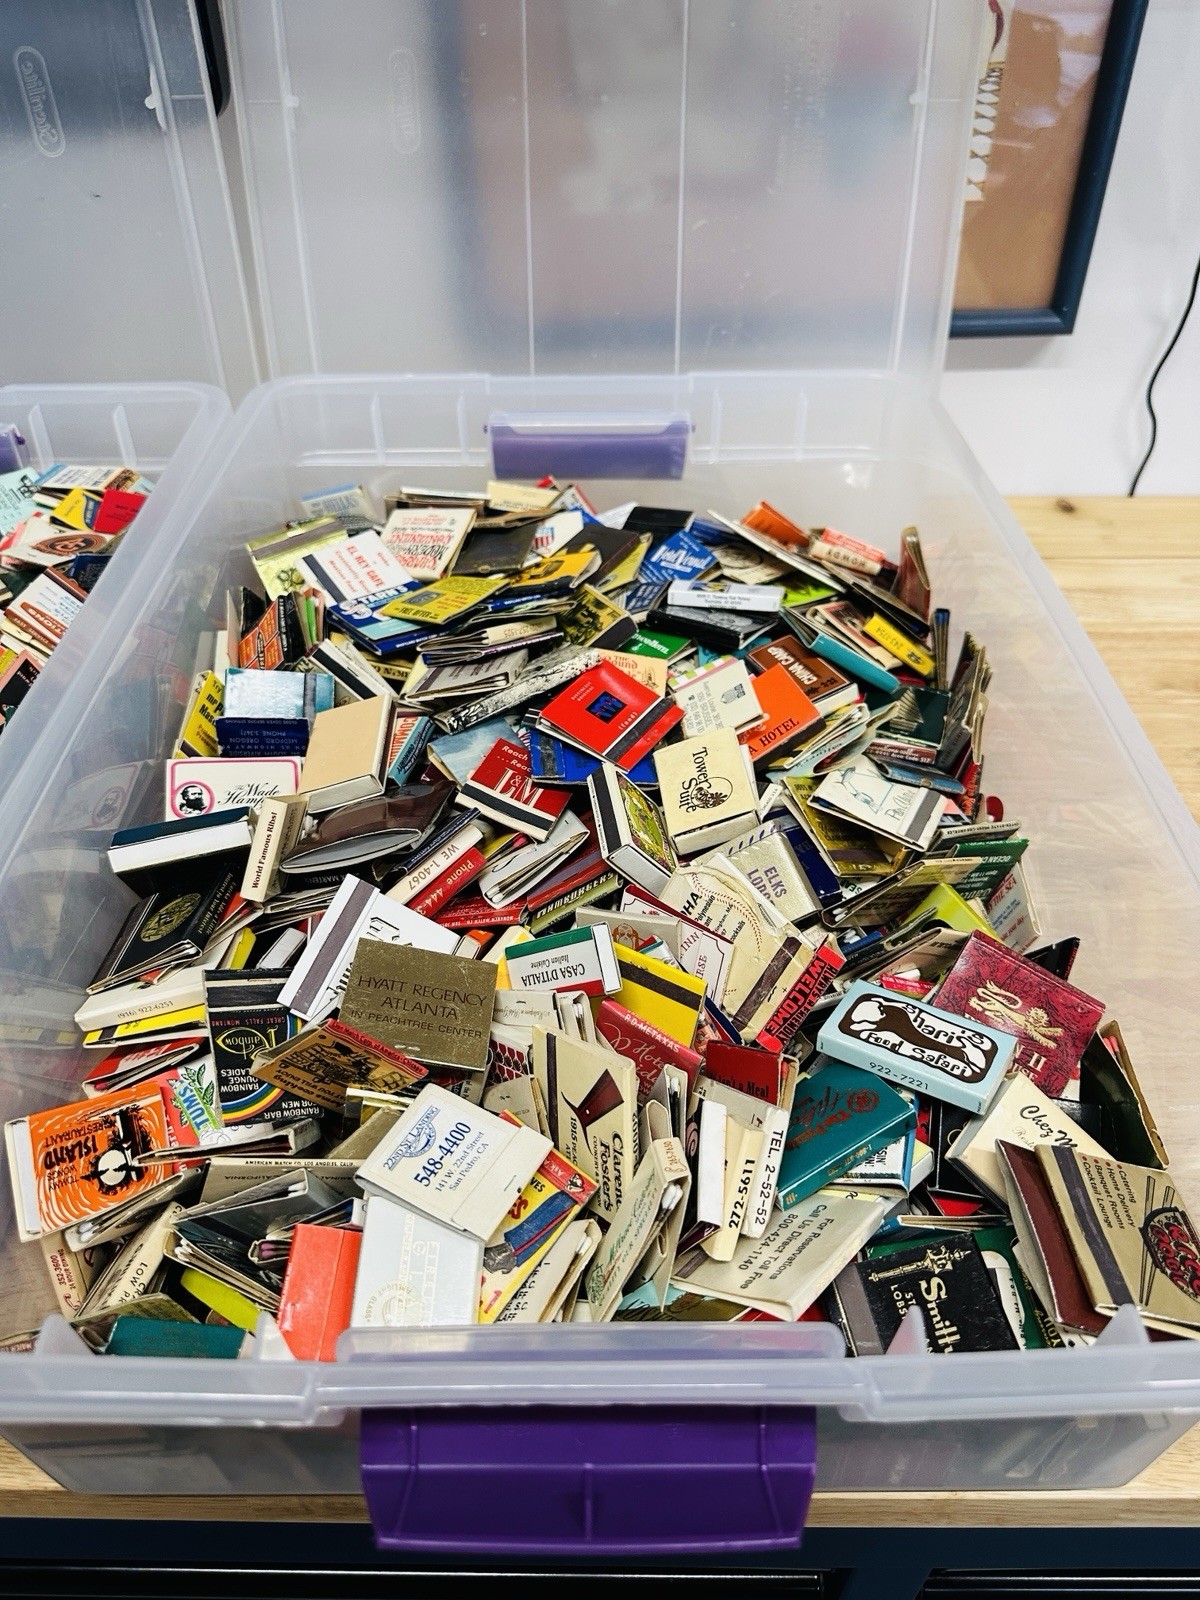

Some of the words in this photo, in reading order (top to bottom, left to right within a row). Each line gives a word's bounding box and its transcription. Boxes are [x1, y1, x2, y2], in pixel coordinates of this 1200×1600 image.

[767, 645, 794, 665] CAMP
[211, 679, 223, 693] Try
[788, 662, 818, 685] CHINA
[758, 717, 800, 748] HOTEL
[501, 744, 529, 761] Reach
[691, 747, 712, 790] Tower
[243, 782, 281, 798] Wade
[494, 768, 545, 808] L&M
[678, 777, 698, 814] Suite
[251, 867, 264, 889] World
[259, 834, 273, 869] Famous
[266, 811, 278, 835] Ribs!
[442, 843, 460, 860] WE
[408, 859, 441, 891] 1-4067
[446, 858, 476, 885] Phone
[763, 865, 788, 899] ELKS
[681, 932, 700, 952] INN
[530, 957, 551, 969] Cuisine
[549, 953, 570, 965] Italian
[560, 962, 586, 979] CASA
[520, 967, 560, 988] D'ITALIA
[811, 964, 838, 1000] ALWAYS
[357, 975, 407, 993] HYATT
[412, 984, 487, 1007] REGENCY
[764, 958, 828, 1036] WELCOME
[117, 1008, 138, 1020] (916)
[138, 1000, 174, 1015] 922-6251
[266, 1017, 286, 1025] GREAT
[380, 996, 458, 1020] ATLANTA
[211, 1019, 241, 1027] MONTANA
[246, 1018, 264, 1026] FALLS
[343, 1027, 360, 1040] Match
[351, 1009, 362, 1019] IN
[367, 1012, 434, 1032] PEACHTREE
[437, 1024, 483, 1039] CENTER
[902, 1003, 986, 1049] Shari's
[866, 1031, 902, 1054] Food
[910, 1047, 968, 1077] Safari
[1028, 1050, 1050, 1074] II
[220, 1068, 252, 1077] LADIES
[228, 1076, 258, 1084] OUNGE
[868, 1060, 930, 1091] 922-7221
[220, 1083, 259, 1093] RAINBOW
[748, 1081, 770, 1098] Meal
[176, 1085, 210, 1131] TUMS
[263, 1109, 282, 1120] BAR
[281, 1101, 301, 1109] MEN
[283, 1106, 321, 1118] RAINBOW
[44, 1118, 108, 1148] RESTAURANT
[569, 1114, 578, 1142] 1915
[1018, 1104, 1054, 1138] Chez
[43, 1132, 99, 1171] ISLAND
[382, 1150, 404, 1172] 22ND
[401, 1137, 415, 1153] ST
[411, 1105, 440, 1143] LANDING
[769, 1129, 784, 1160] TEL.
[413, 1121, 472, 1188] 548-4400
[434, 1177, 449, 1193] 141
[445, 1167, 456, 1181] W.
[453, 1151, 469, 1169] 22nd
[465, 1131, 486, 1152] Street
[449, 1175, 465, 1193] San
[461, 1156, 481, 1179] Pedro,
[476, 1141, 490, 1158] CA
[48, 1176, 80, 1192] TOMMY
[553, 1164, 568, 1179] Ask
[728, 1159, 756, 1230] 272-5611
[754, 1164, 777, 1226] 2-52-52
[1082, 1160, 1103, 1199] Cocktail
[1096, 1199, 1115, 1230] Lounge
[1093, 1163, 1113, 1199] Banquet
[1107, 1200, 1127, 1231] Rooms
[1107, 1166, 1122, 1189] Home
[1116, 1187, 1136, 1229] Delivery
[1117, 1169, 1137, 1204] Catering
[798, 1219, 815, 1230] Us
[809, 1204, 828, 1219] Call
[816, 1217, 835, 1231] For
[738, 1212, 799, 1271] 800-424-1140
[774, 1230, 803, 1254] Direct
[759, 1255, 780, 1271] Toll
[769, 1231, 822, 1280] Reservations
[50, 1253, 67, 1286] 352-3600
[129, 1262, 149, 1288] LOW
[740, 1271, 764, 1290] Free
